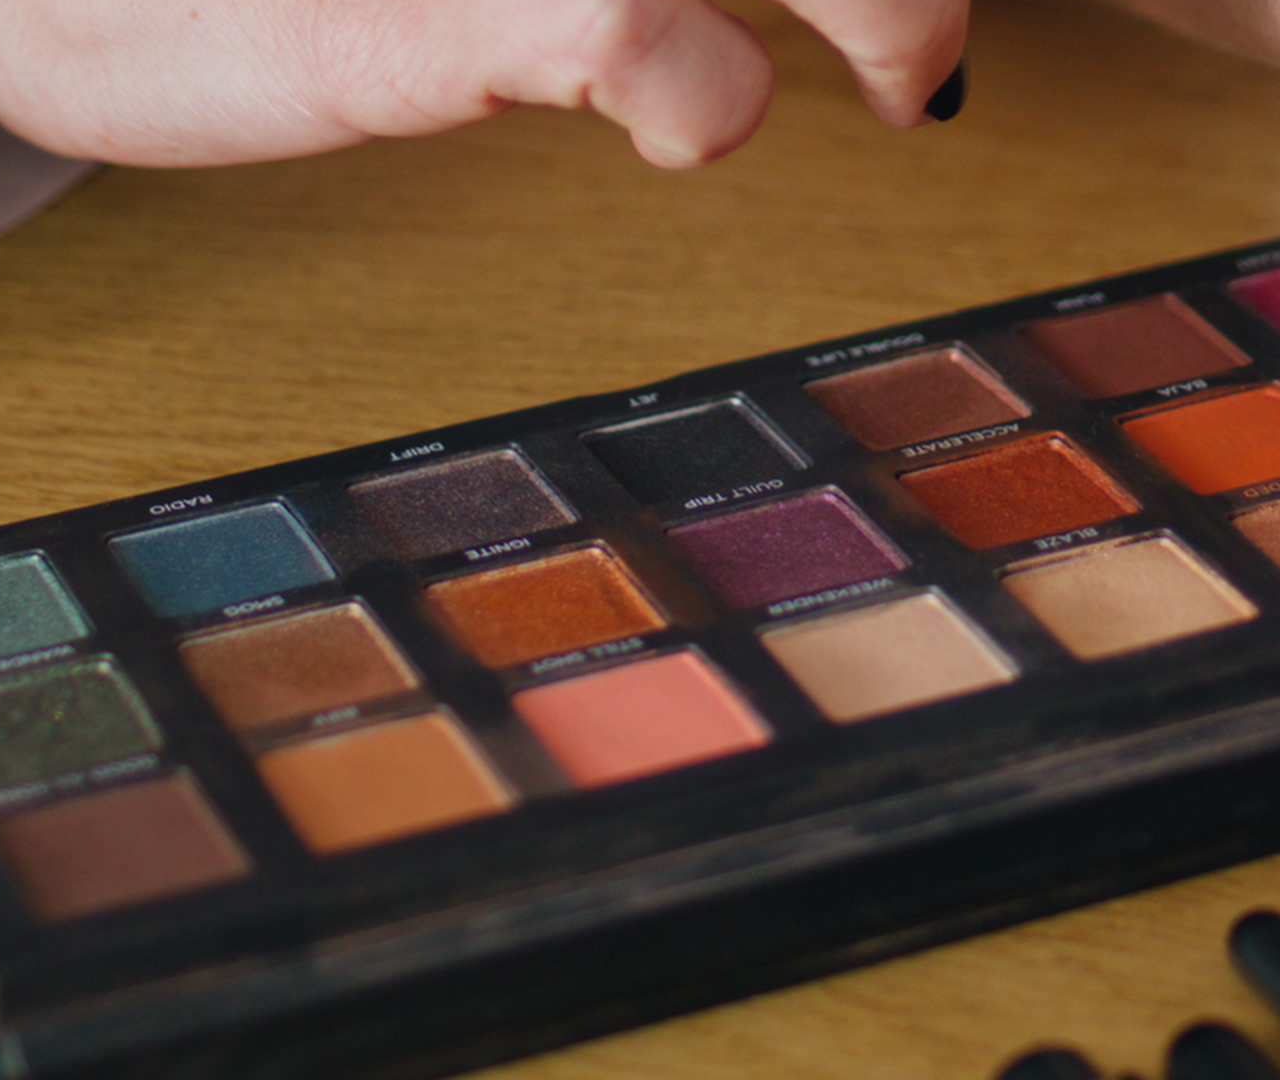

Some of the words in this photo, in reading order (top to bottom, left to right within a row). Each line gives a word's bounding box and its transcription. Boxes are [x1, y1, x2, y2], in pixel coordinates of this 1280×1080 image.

[849, 334, 923, 356] DOUBLE
[806, 352, 846, 366] LIFE
[1158, 379, 1207, 395] BAJA
[629, 393, 658, 407] JET
[902, 424, 1018, 456] ACCELERATE
[391, 443, 444, 461] DRIFT
[732, 480, 783, 498] GUILT
[150, 495, 212, 514] RADIO
[685, 494, 726, 508] TRIP
[1034, 528, 1098, 549] BLAZE
[465, 538, 530, 560] IGNITE
[222, 595, 284, 617] SMOG
[769, 579, 894, 614] WEEKENDER
[588, 638, 642, 658] STILL
[533, 652, 585, 673] SHOT
